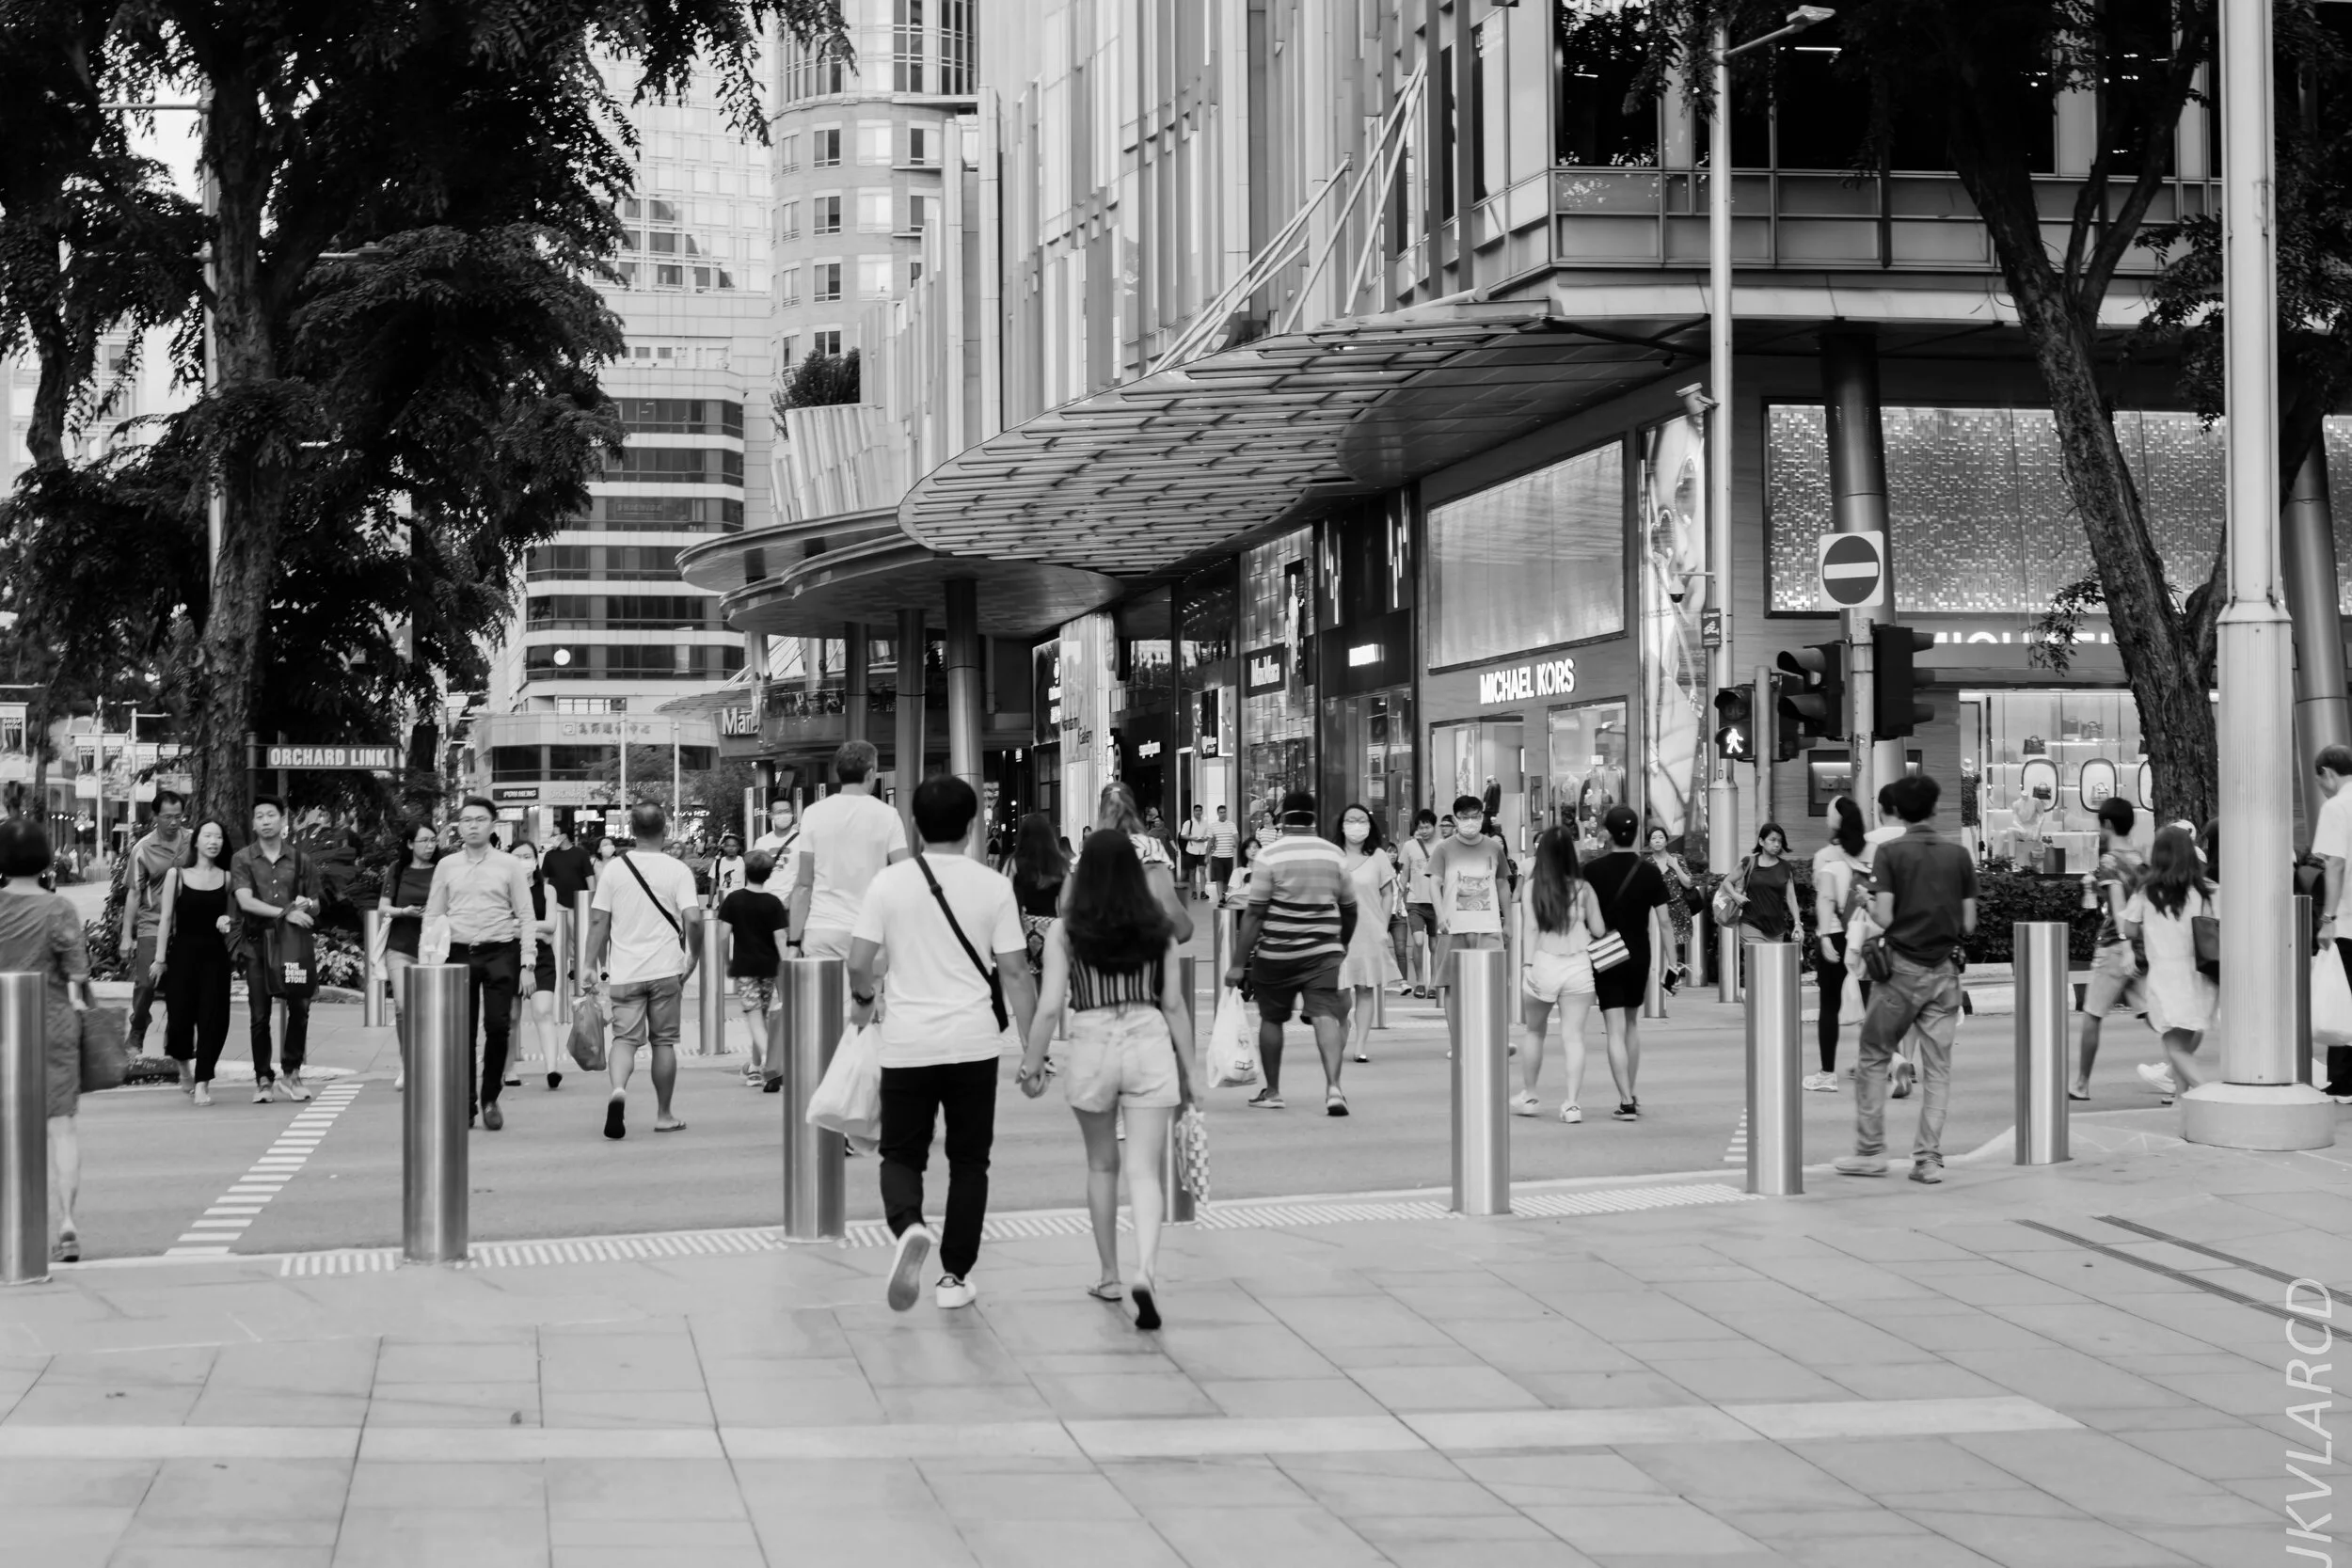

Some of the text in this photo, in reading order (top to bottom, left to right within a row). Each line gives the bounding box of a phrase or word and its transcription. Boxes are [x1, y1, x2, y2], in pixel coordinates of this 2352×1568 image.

[1480, 657, 1575, 705] MICHAEL KORS
[270, 748, 387, 767] ORCHARD LINK
